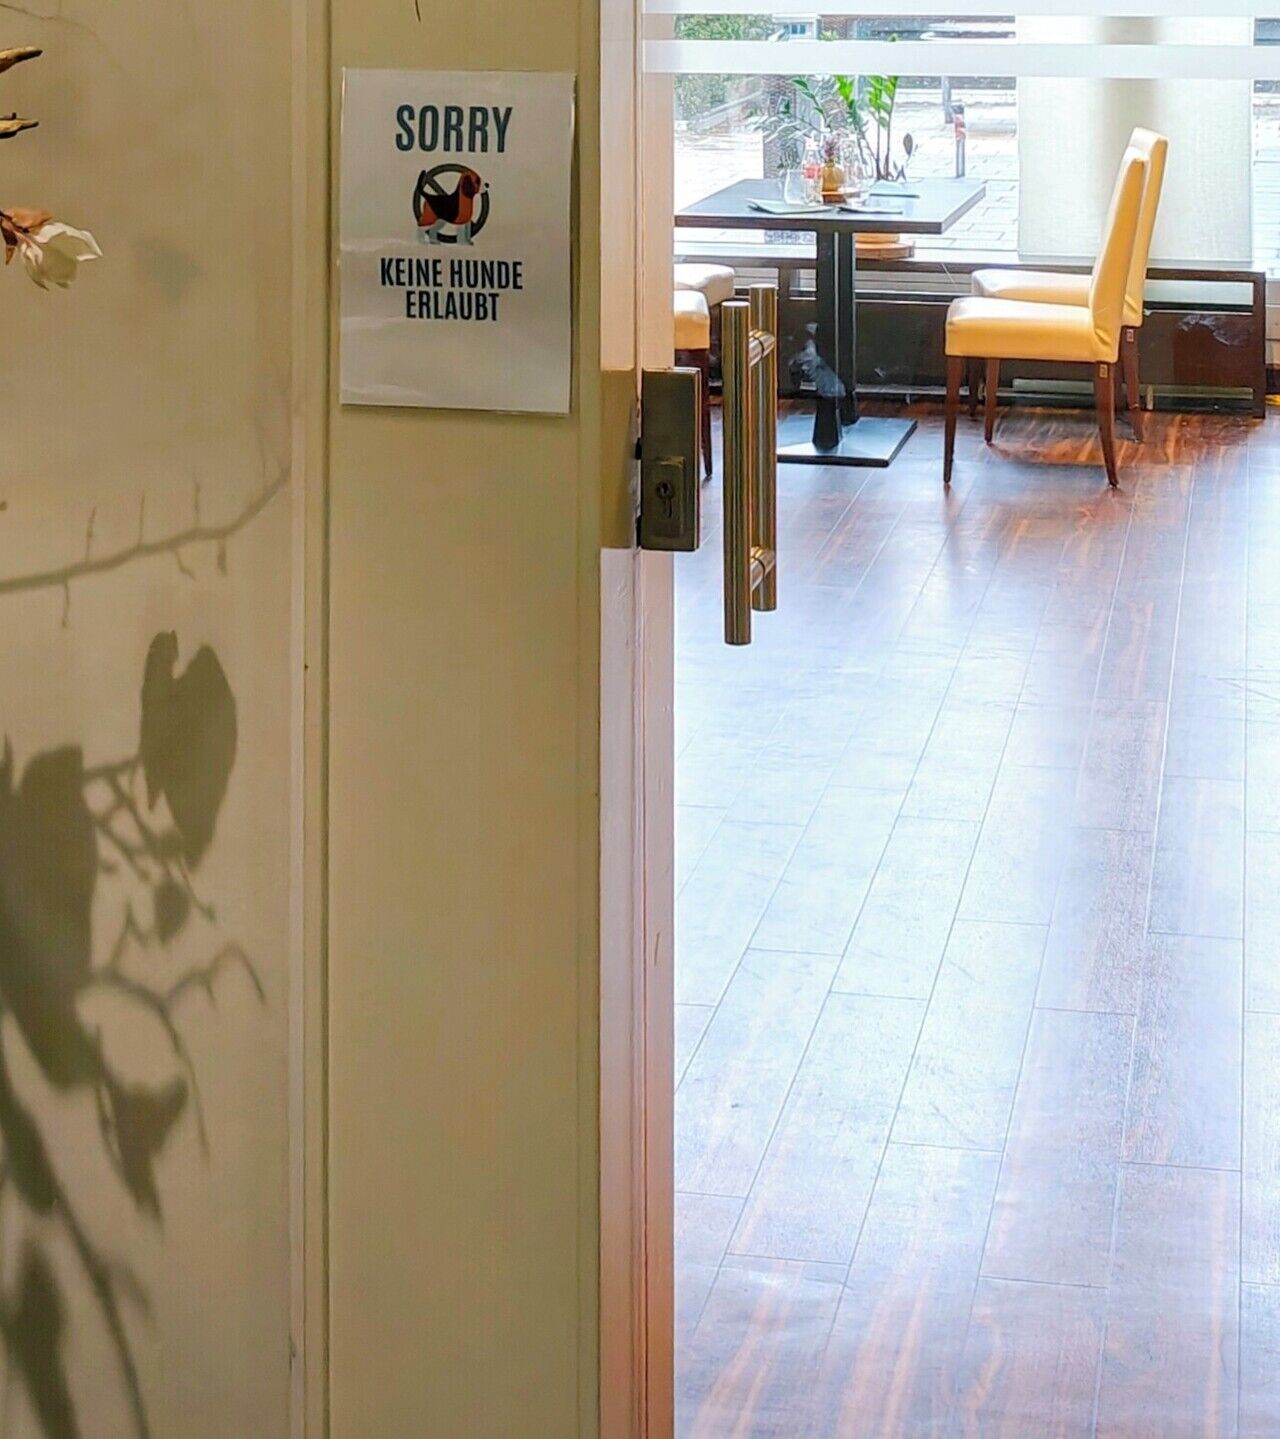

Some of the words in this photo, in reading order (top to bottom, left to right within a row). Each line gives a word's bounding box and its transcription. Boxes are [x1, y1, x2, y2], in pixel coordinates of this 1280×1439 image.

[395, 104, 513, 153] SORRY
[380, 257, 442, 287] KEINE
[450, 259, 523, 290] HUNDE
[405, 290, 500, 321] ERLAUBT
